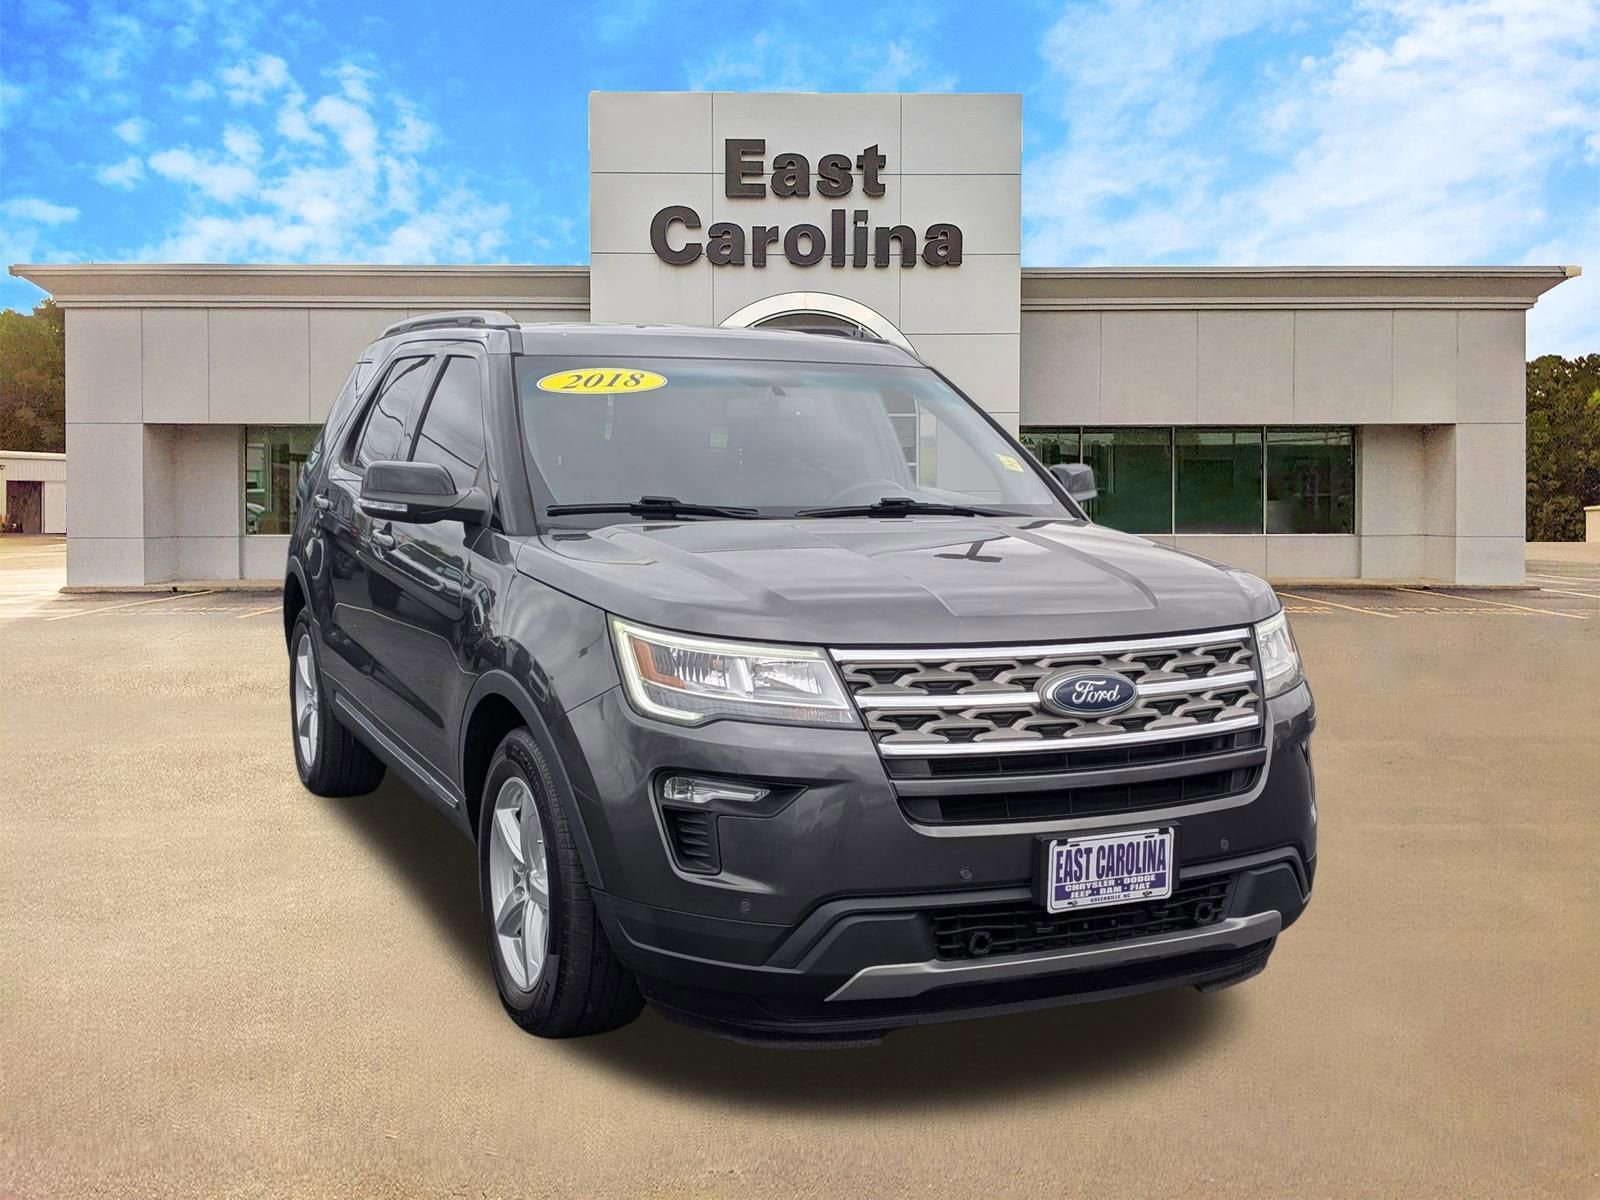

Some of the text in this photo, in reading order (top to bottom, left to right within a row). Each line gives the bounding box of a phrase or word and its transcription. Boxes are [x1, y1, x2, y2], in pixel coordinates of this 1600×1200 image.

[725, 138, 886, 198] East
[650, 205, 963, 267] Carolina
[560, 372, 645, 389] 2018
[1072, 680, 1120, 704] Ford
[1055, 838, 1166, 884] EAST CAROLINA
[1065, 874, 1156, 892] CHRYSLER DODGE
[1071, 882, 1151, 899] JEEP RAM FIAT
